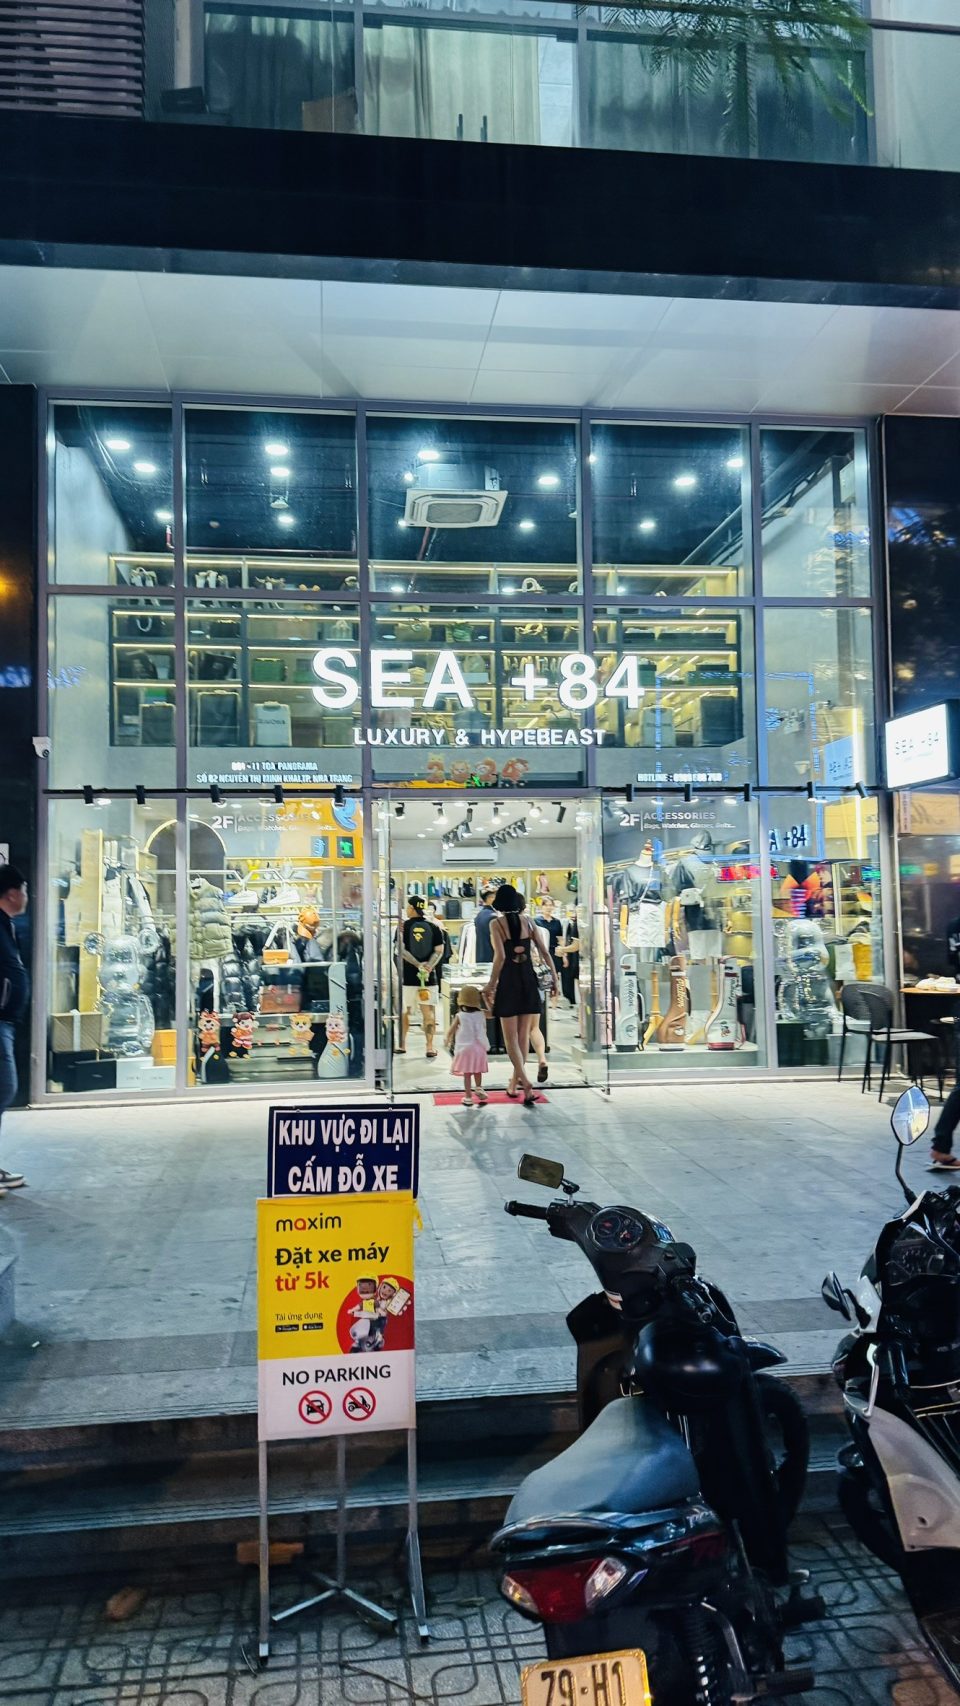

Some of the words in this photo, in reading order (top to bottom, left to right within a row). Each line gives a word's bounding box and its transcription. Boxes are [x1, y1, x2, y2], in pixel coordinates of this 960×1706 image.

[312, 648, 473, 709] SEA
[511, 654, 645, 709] +84
[353, 727, 445, 745] LUXURY
[455, 729, 469, 745] &
[481, 728, 606, 746] HYPEBEAST
[329, 774, 353, 783] TRANG
[211, 815, 234, 829] 2F
[620, 813, 640, 827] 2F
[643, 811, 716, 821] ACCESSORIES
[278, 1119, 315, 1146] KHU
[320, 1114, 356, 1153] VỰC
[360, 1118, 377, 1144] ĐI
[382, 1118, 409, 1152] LẠI
[288, 1155, 332, 1193] CẤM
[337, 1153, 366, 1192] ĐỖ
[371, 1165, 399, 1191] XE
[276, 1212, 342, 1232] maxim
[275, 1247, 312, 1269] Đặt
[318, 1249, 342, 1264] xe
[347, 1242, 390, 1263] máy
[275, 1273, 300, 1292] từ
[304, 1271, 330, 1290] 5k
[282, 1370, 310, 1386] NO
[314, 1364, 391, 1384] PARKING
